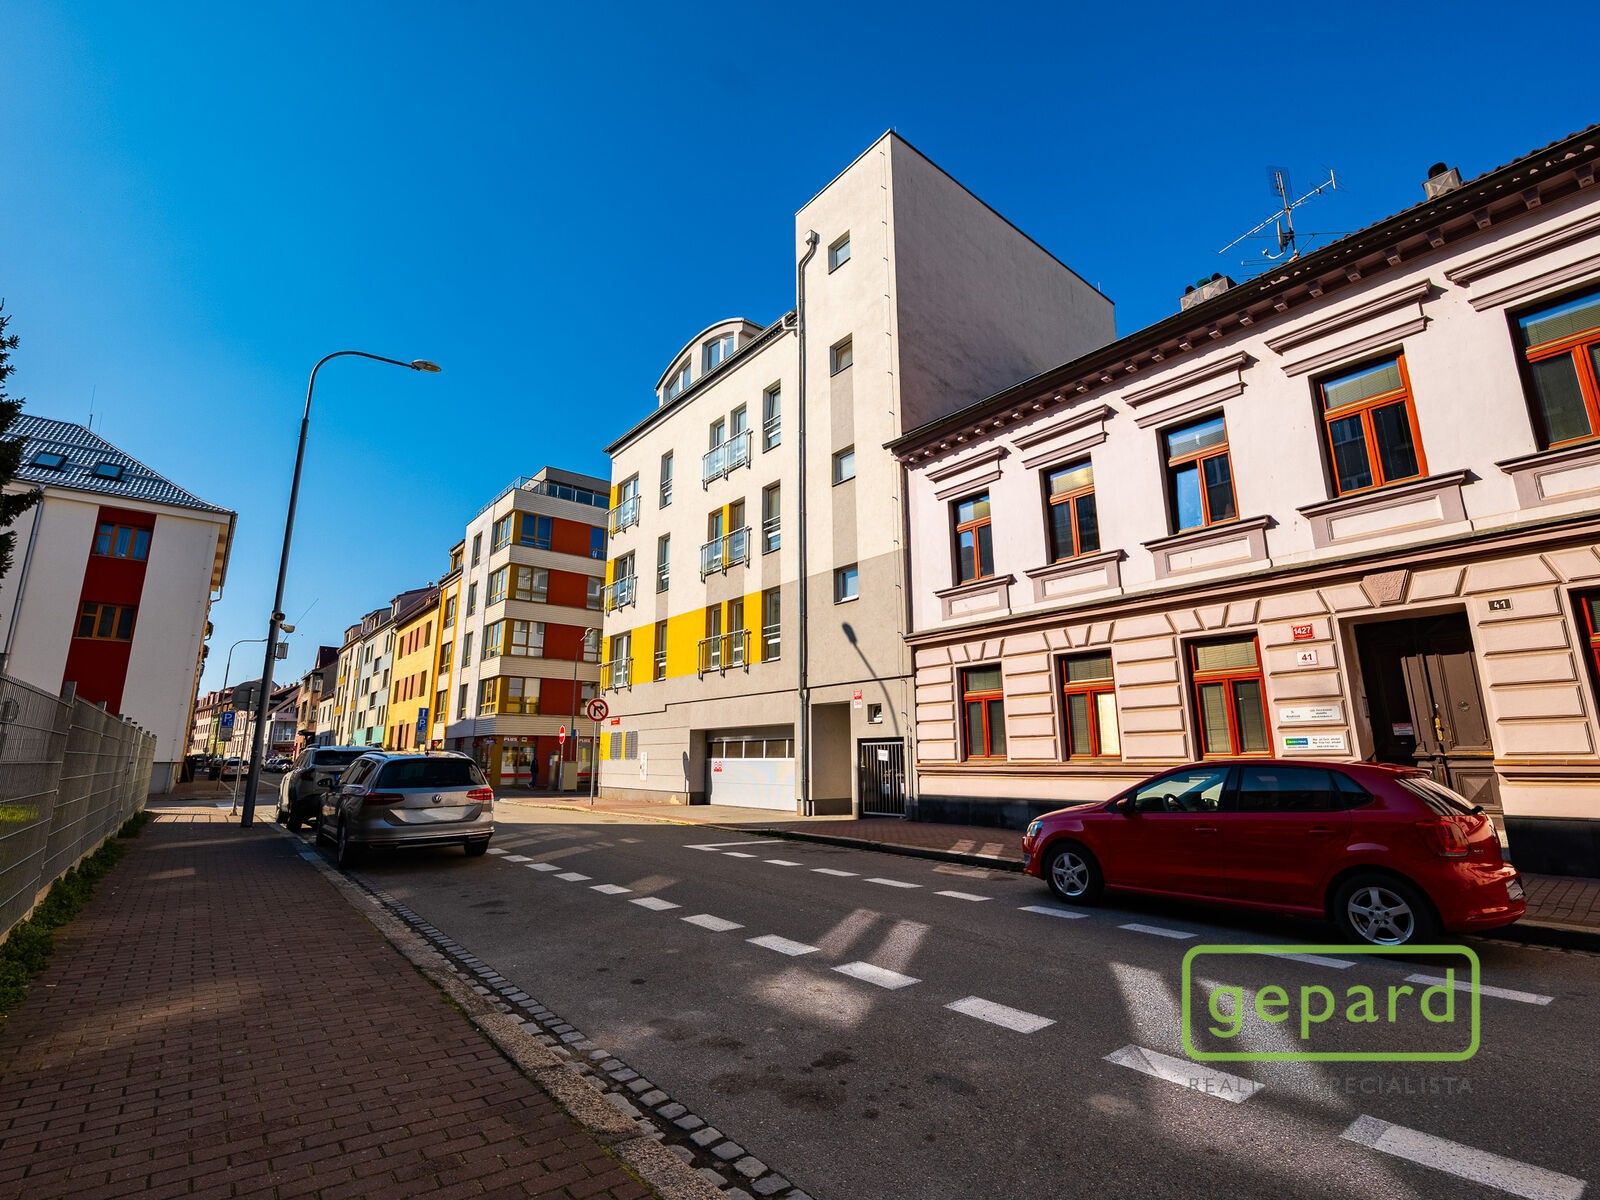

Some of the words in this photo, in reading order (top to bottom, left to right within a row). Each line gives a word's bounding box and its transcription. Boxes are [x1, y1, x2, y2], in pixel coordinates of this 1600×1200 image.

[1493, 600, 1506, 609] 41
[1293, 626, 1311, 635] 1427
[1301, 653, 1313, 661] 41
